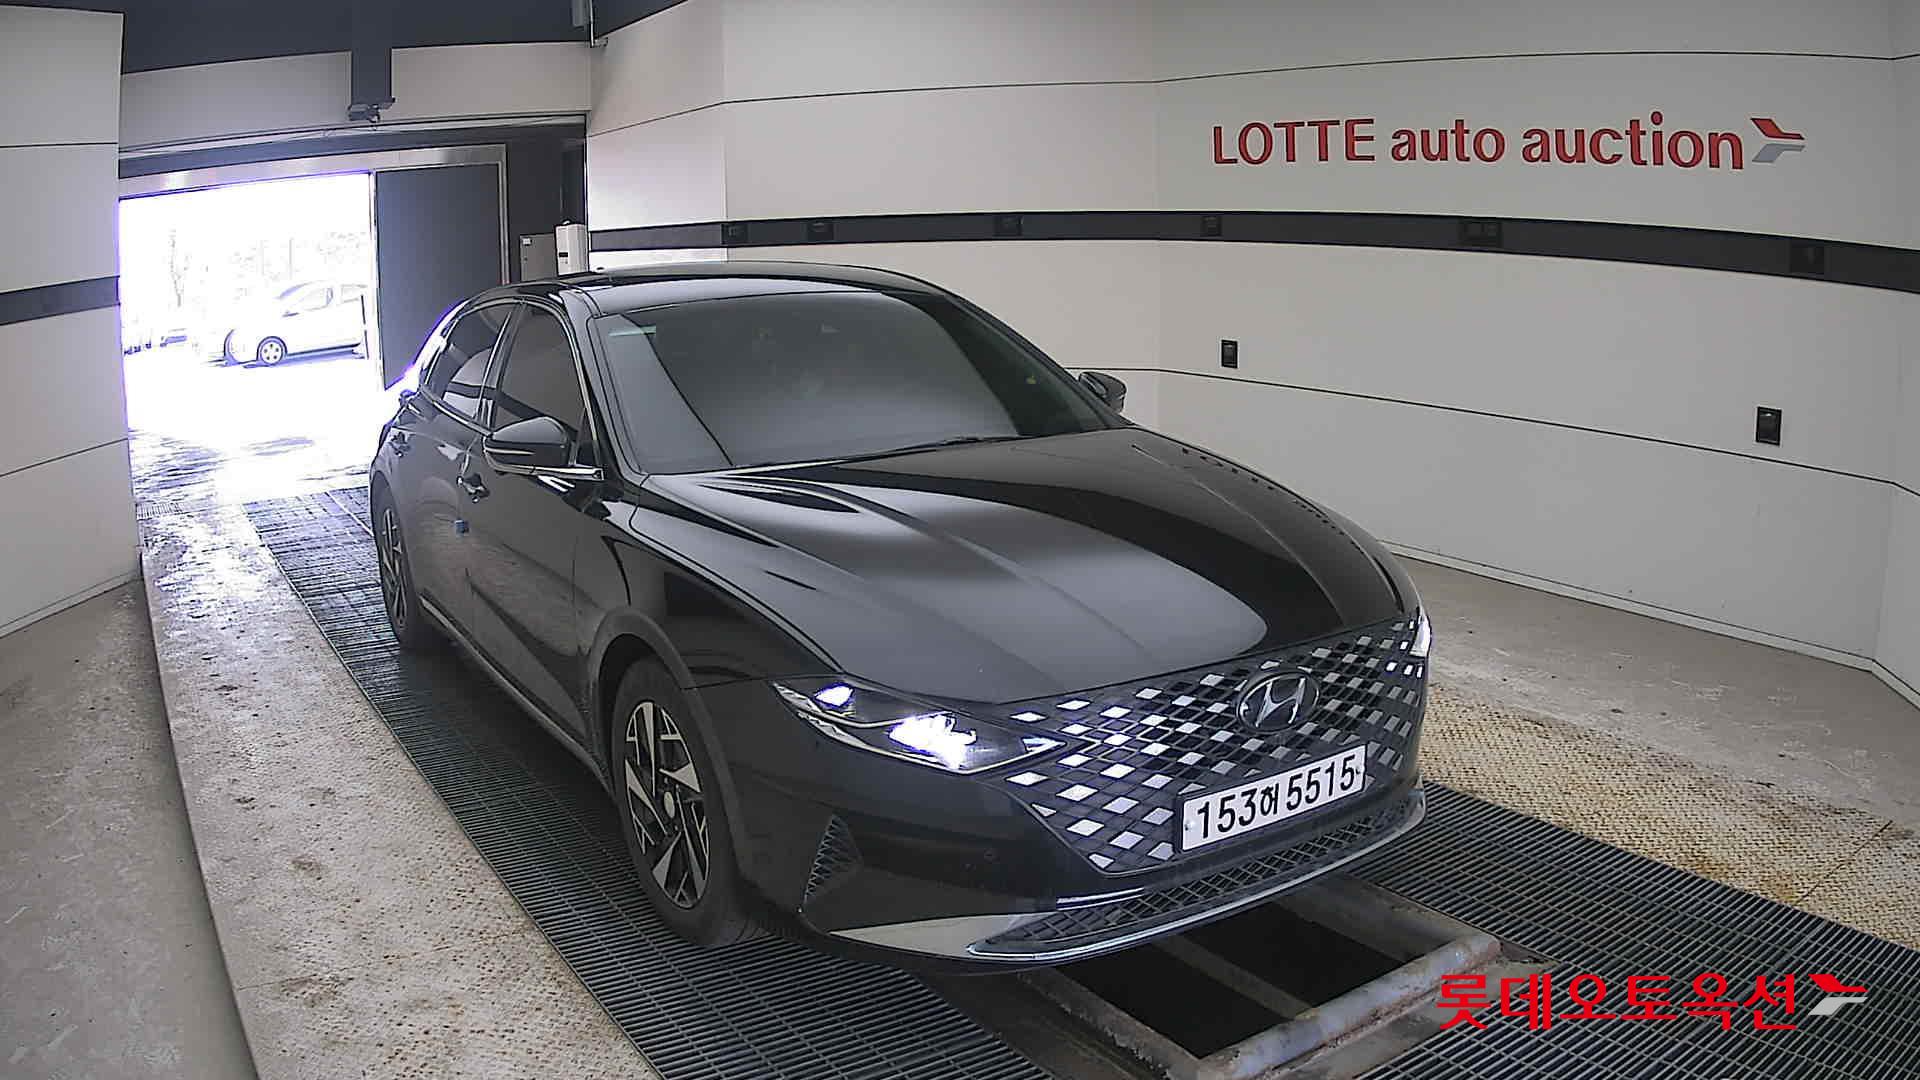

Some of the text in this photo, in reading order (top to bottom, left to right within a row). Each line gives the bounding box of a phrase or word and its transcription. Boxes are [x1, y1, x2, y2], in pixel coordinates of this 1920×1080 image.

[1212, 111, 1744, 170] LOTTE auto auction
[1197, 755, 1356, 839] 153허 5515
